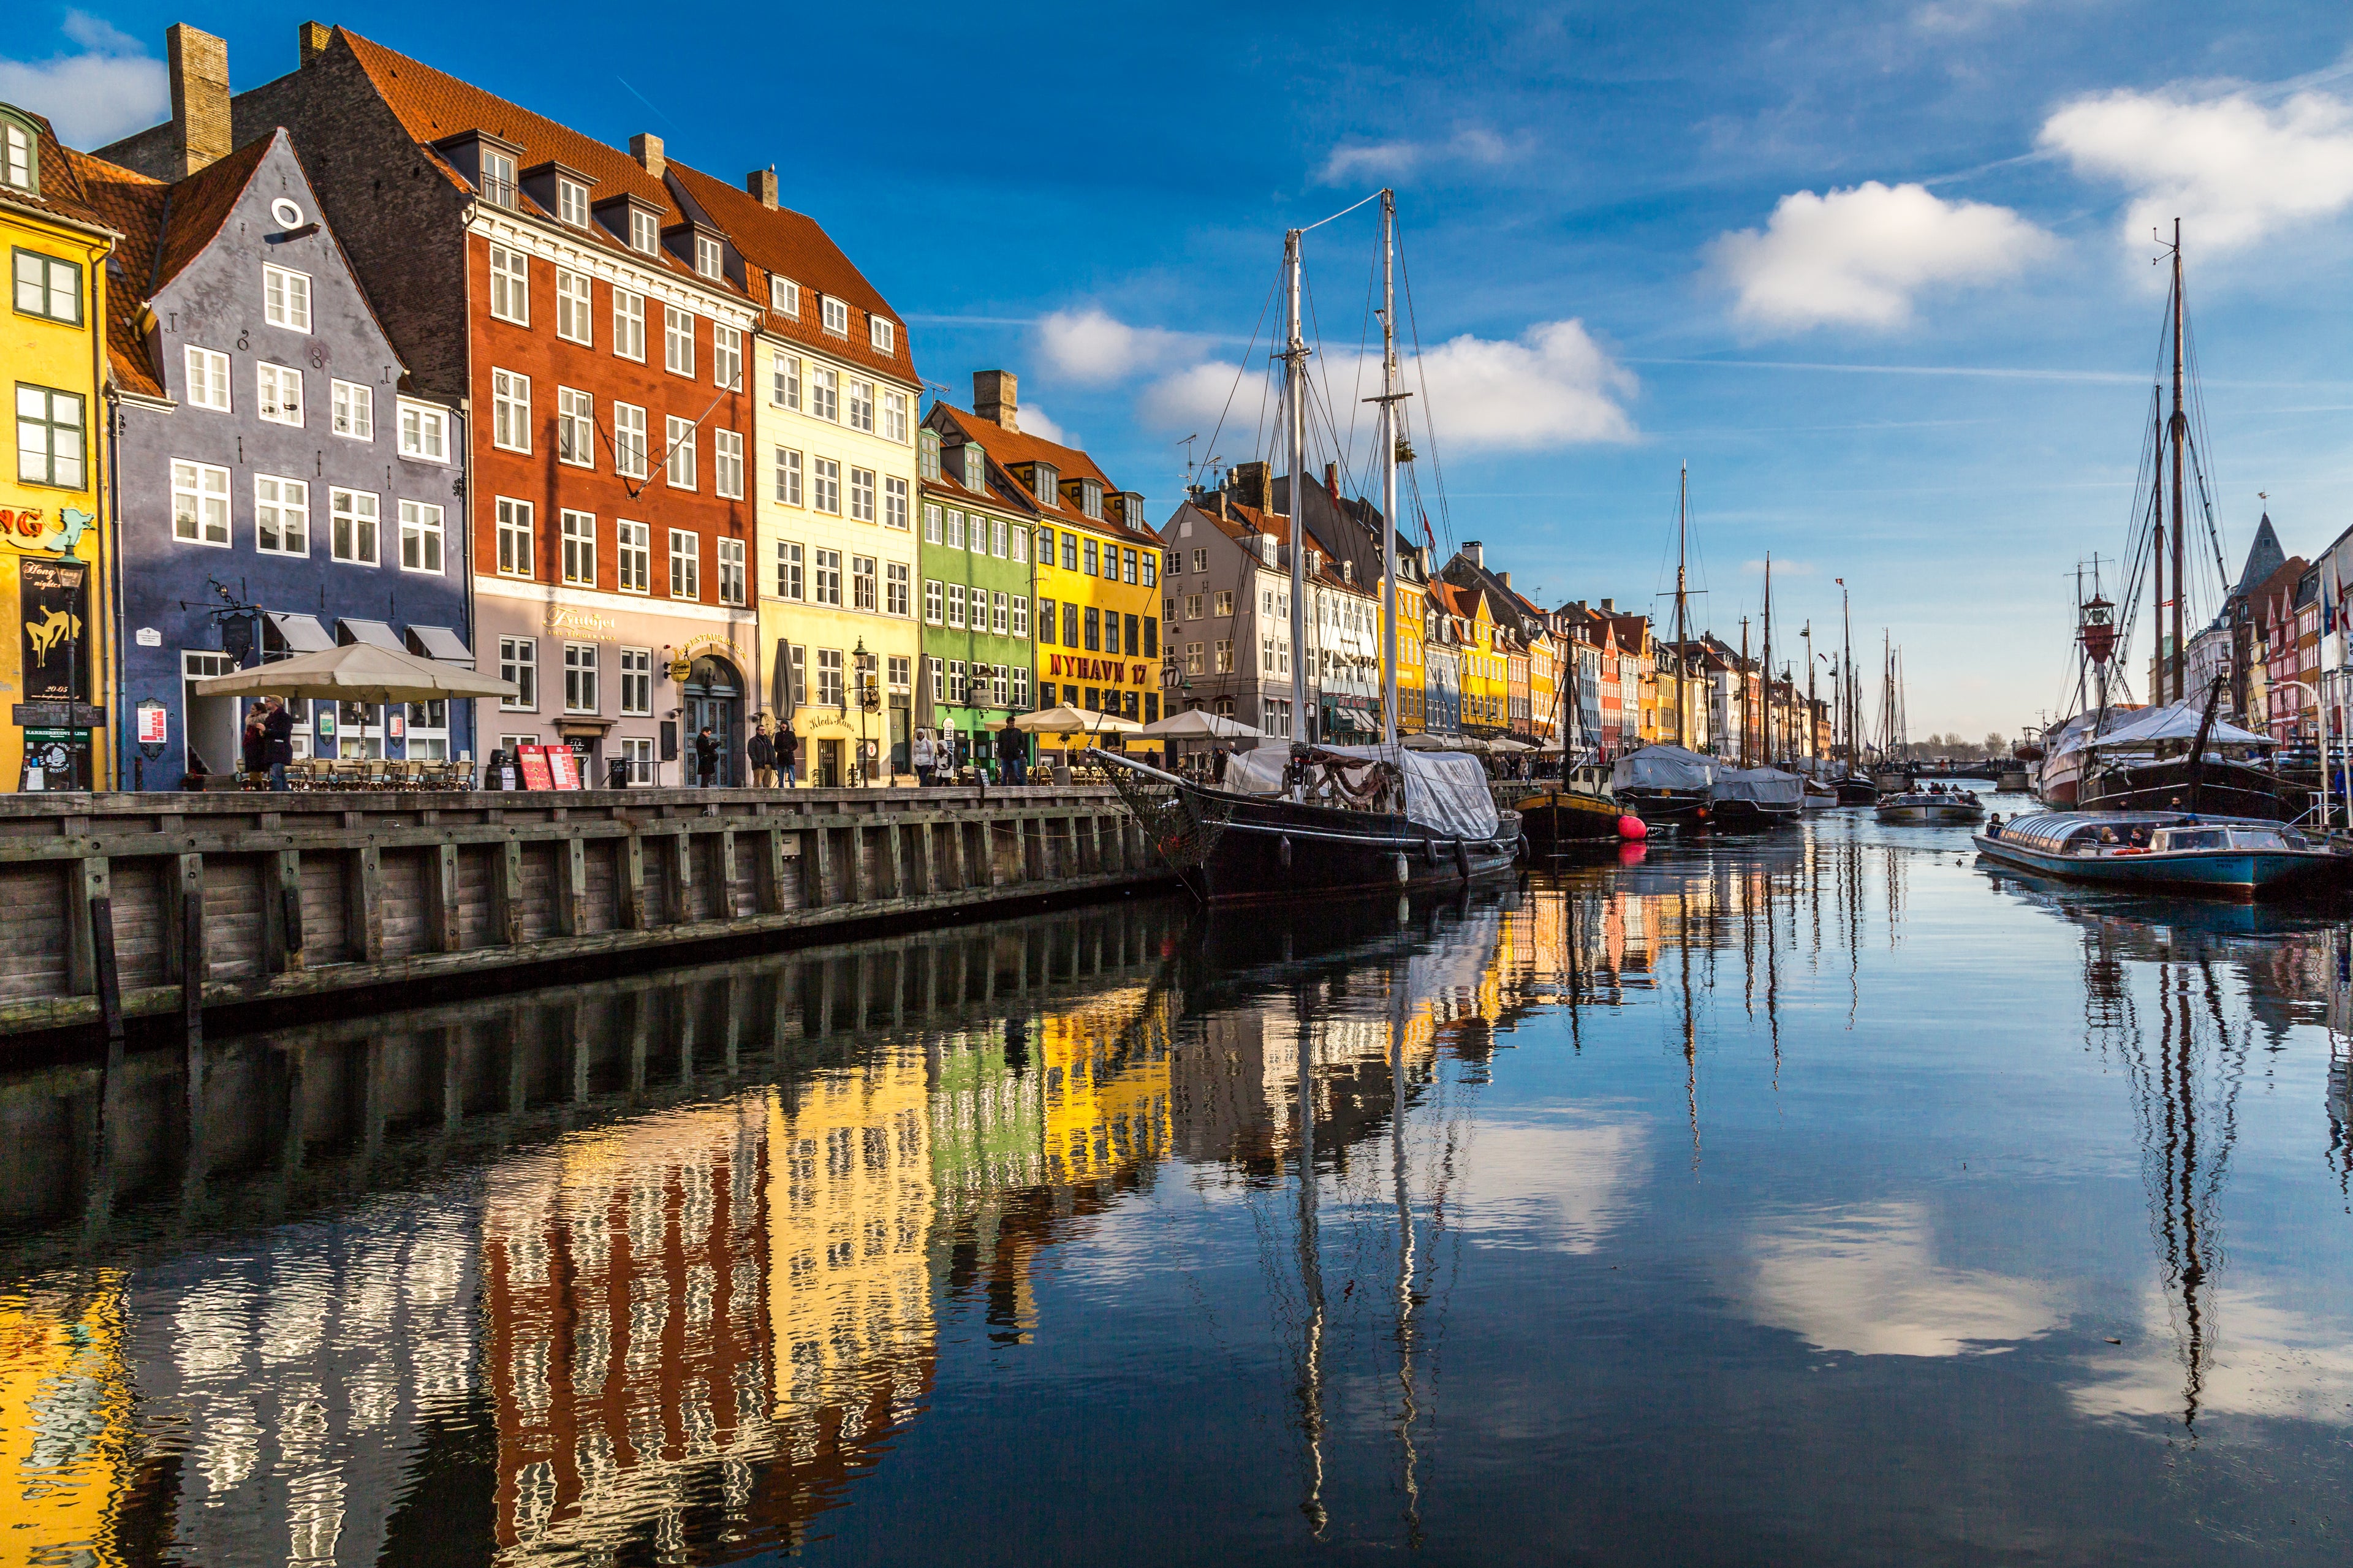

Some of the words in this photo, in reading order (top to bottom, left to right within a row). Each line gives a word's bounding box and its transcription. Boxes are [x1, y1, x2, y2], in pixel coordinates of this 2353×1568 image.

[22, 561, 56, 580] Hong
[684, 633, 744, 654] RESTAURANT
[1050, 653, 1124, 683] NYHAVN
[1132, 664, 1148, 684] 17
[1160, 668, 1176, 687] 17
[809, 715, 833, 730] Klods
[834, 714, 854, 732] Hans
[41, 742, 55, 751] HONG
[57, 742, 71, 752] KONG
